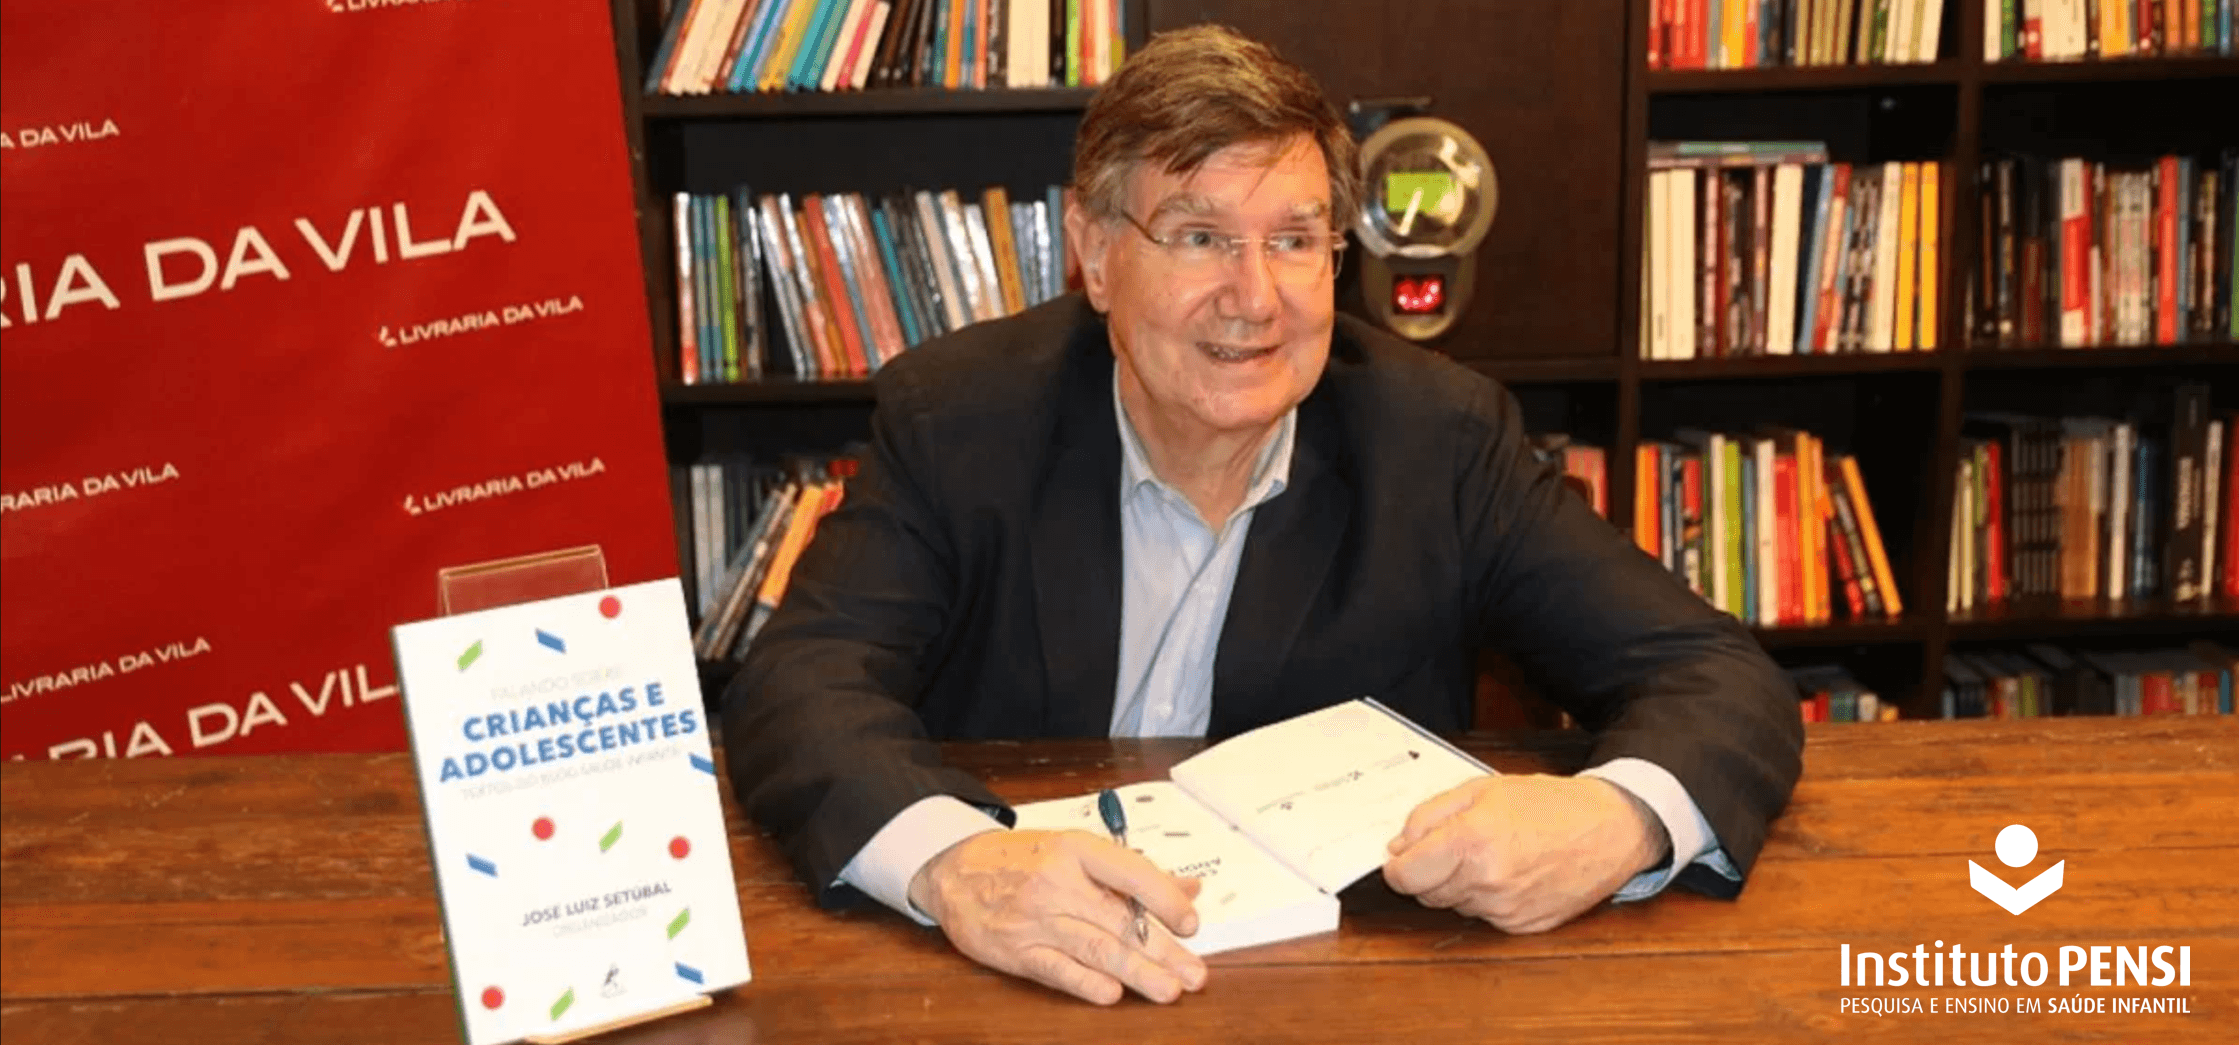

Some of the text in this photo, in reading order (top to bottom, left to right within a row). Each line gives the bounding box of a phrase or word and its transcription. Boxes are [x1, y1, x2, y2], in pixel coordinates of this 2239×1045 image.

[19, 126, 58, 148] DA
[58, 118, 120, 142] VILA
[143, 226, 291, 302] DA
[293, 189, 517, 272] VILA
[398, 295, 584, 345] LIVRARIA DA VILA
[82, 474, 121, 497] DA
[120, 462, 180, 488] VILA
[423, 457, 605, 513] LIVRARIA DA VILA
[118, 651, 154, 673] DA
[155, 637, 212, 663] VILA
[187, 691, 288, 748] DA
[289, 664, 401, 717] VIL
[462, 681, 664, 742] CRIANÇAS E
[440, 709, 697, 782] ADOLESCENTES
[565, 896, 600, 917] LUIZ
